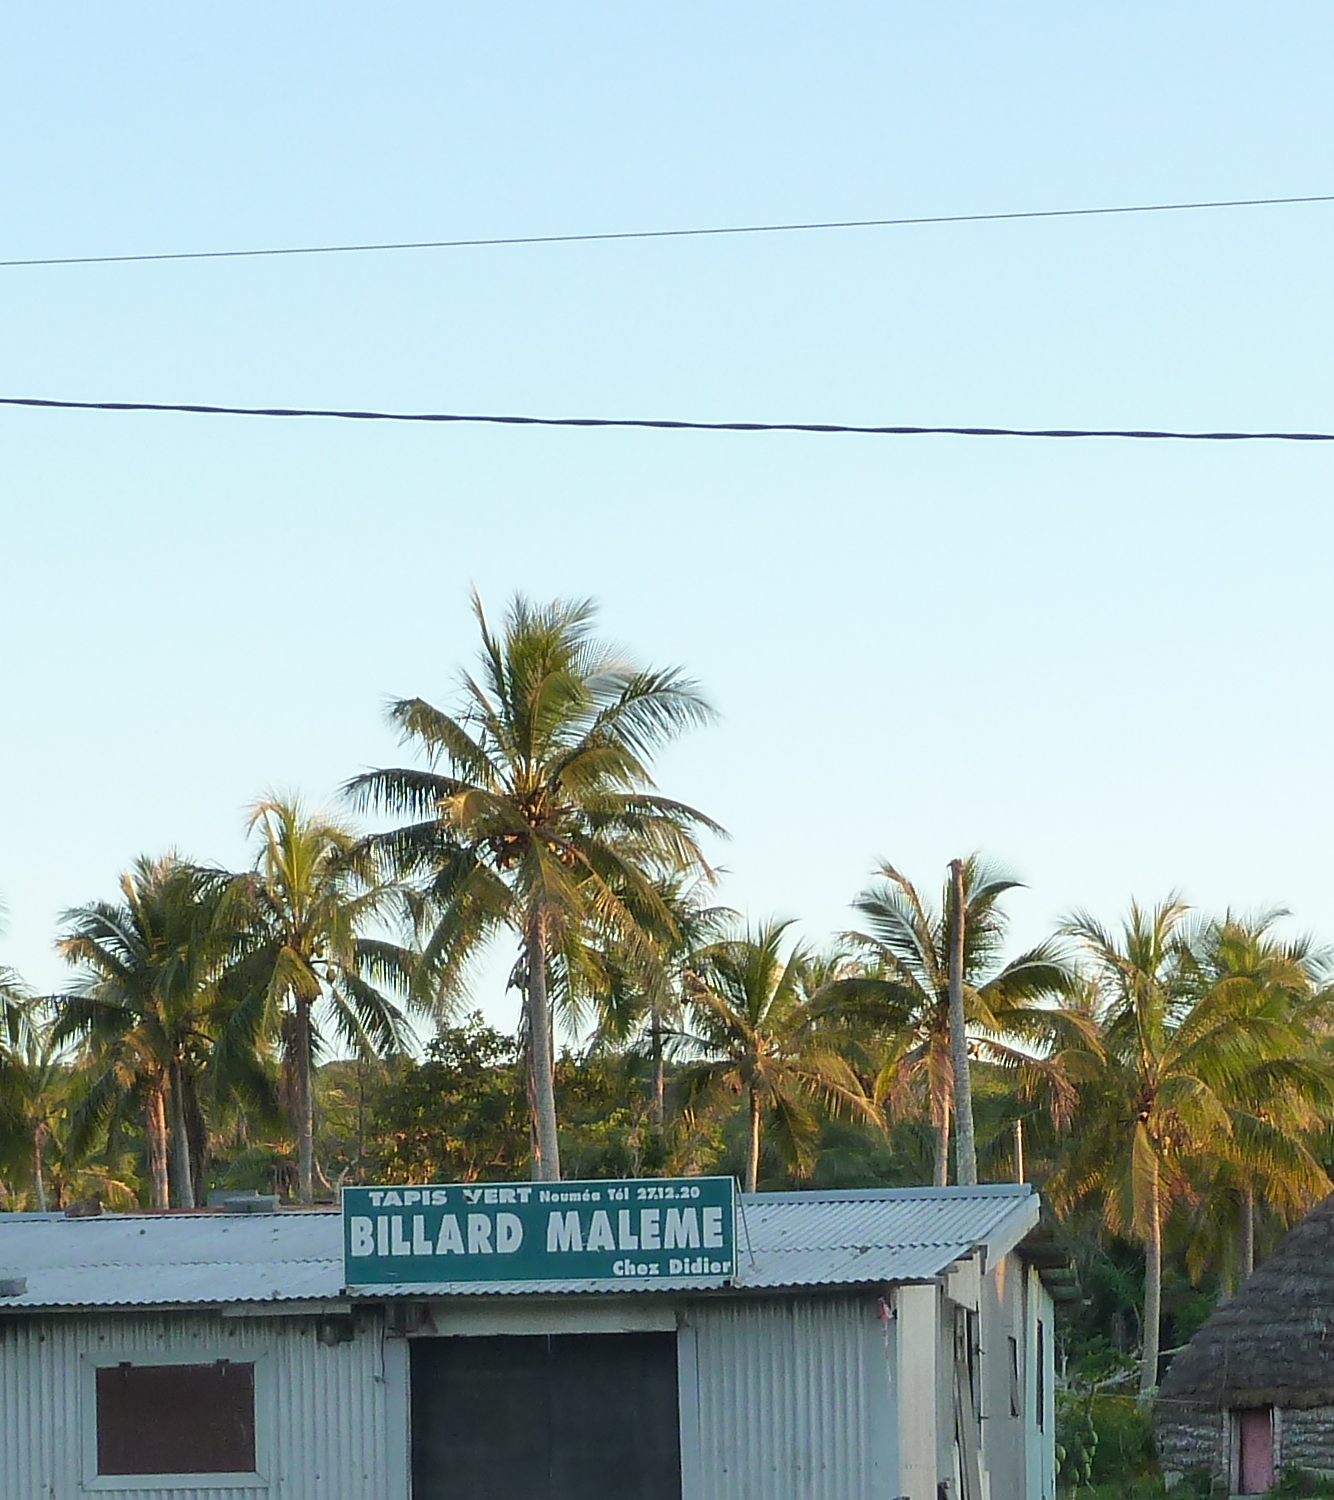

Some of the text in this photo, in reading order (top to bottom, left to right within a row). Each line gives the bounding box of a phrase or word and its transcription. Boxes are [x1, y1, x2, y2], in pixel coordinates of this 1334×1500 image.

[369, 1186, 700, 1207] TAPIS VERT Nouméa Tél 27.12.20
[351, 1206, 724, 1257] BILLARD MALEME
[612, 1256, 731, 1276] Chez Didier
